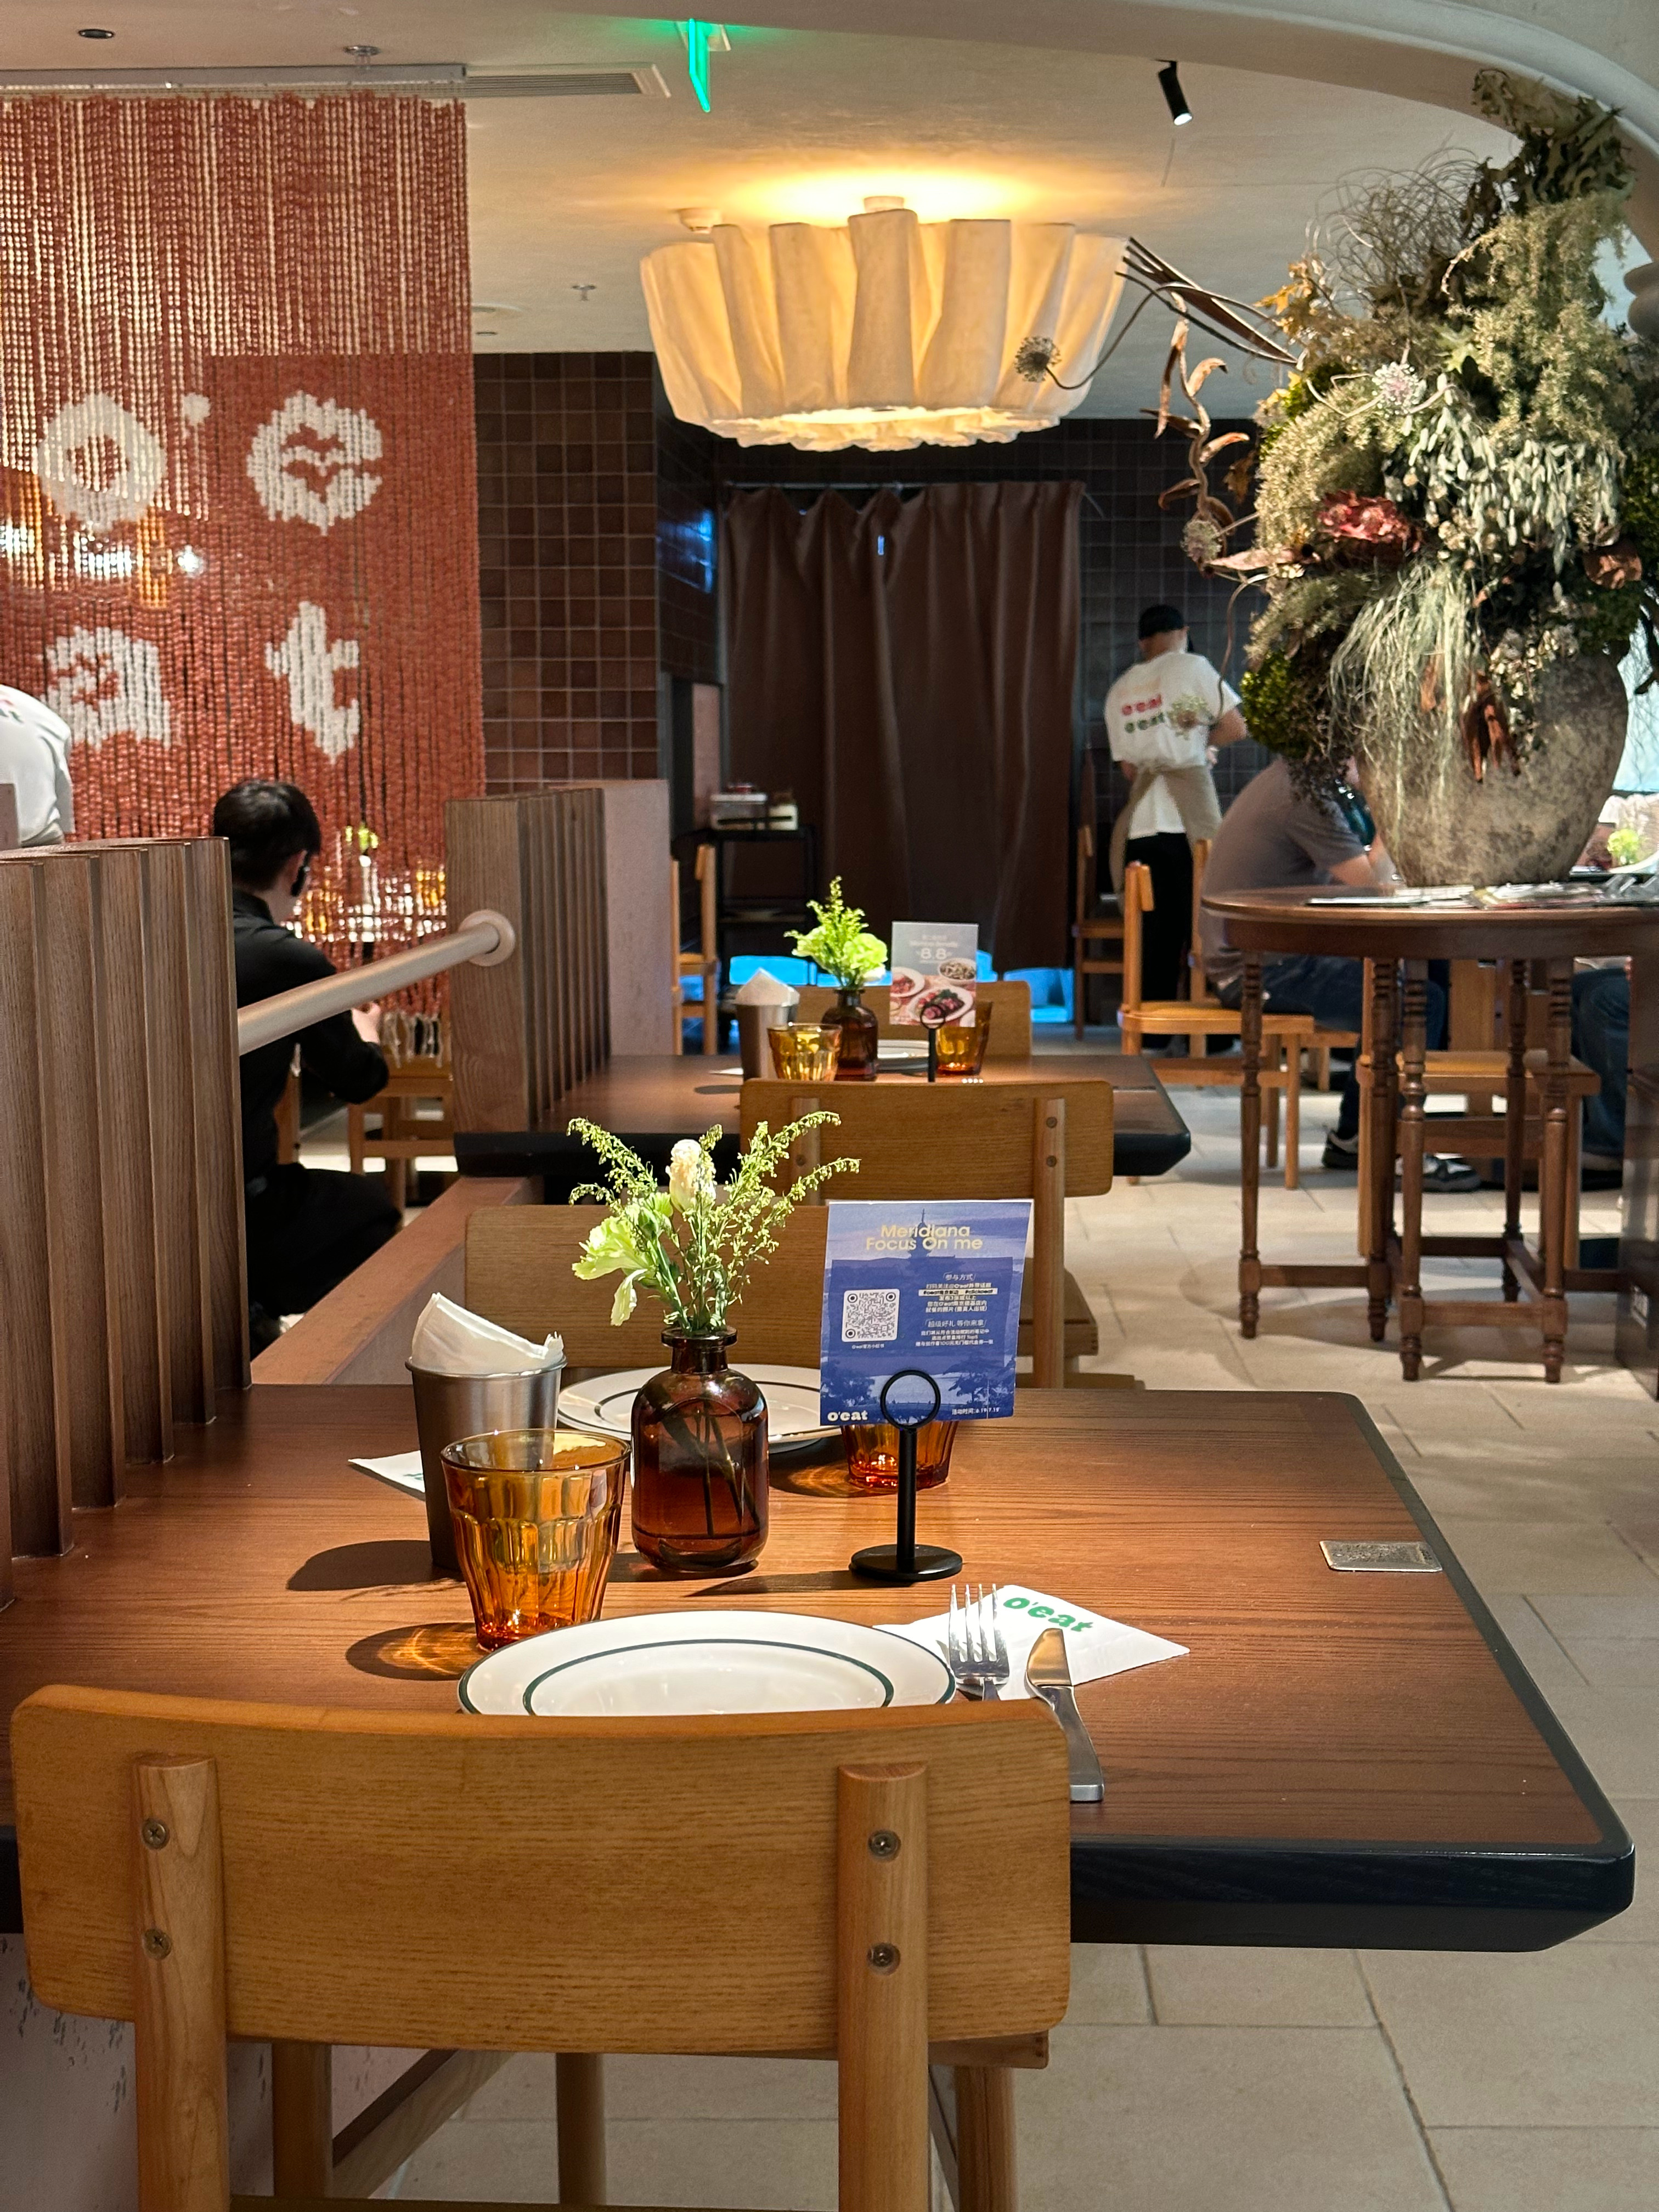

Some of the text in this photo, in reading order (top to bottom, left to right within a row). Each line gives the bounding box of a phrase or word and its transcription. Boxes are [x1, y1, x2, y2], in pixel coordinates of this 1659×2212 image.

[881, 1223, 970, 1238] Meridiana
[866, 1237, 984, 1251] Focus On me
[827, 1410, 868, 1421] o'eat
[1003, 1598, 1093, 1632] o'eat
